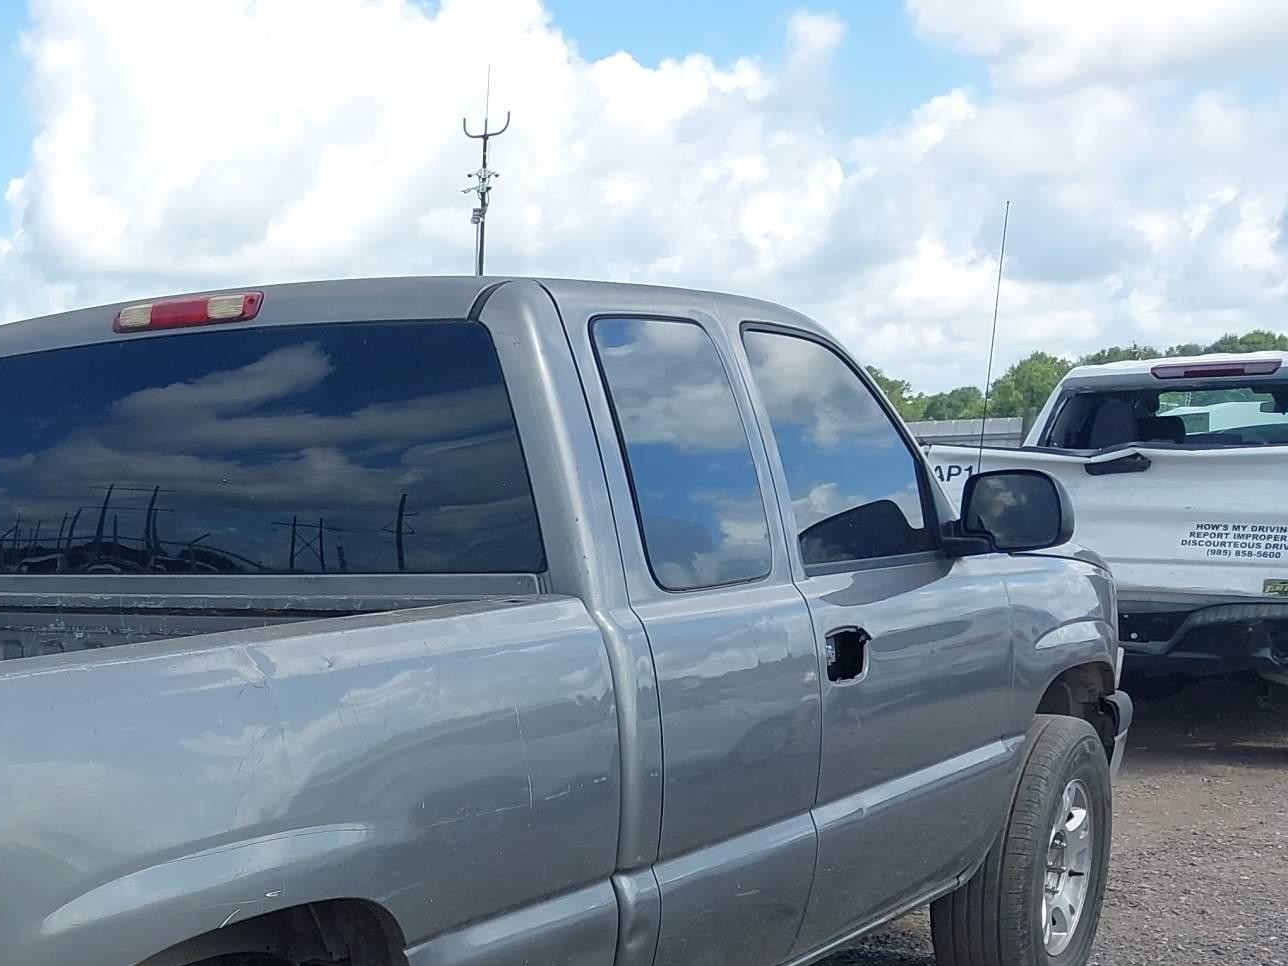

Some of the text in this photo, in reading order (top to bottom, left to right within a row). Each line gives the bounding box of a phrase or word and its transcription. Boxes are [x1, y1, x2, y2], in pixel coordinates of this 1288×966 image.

[1196, 523, 1229, 531] HOW'S
[1189, 532, 1288, 542] REPORT IMPROPER
[1181, 539, 1262, 550] DISCOURTEOUS
[1206, 549, 1281, 559] (985) 858-5600
